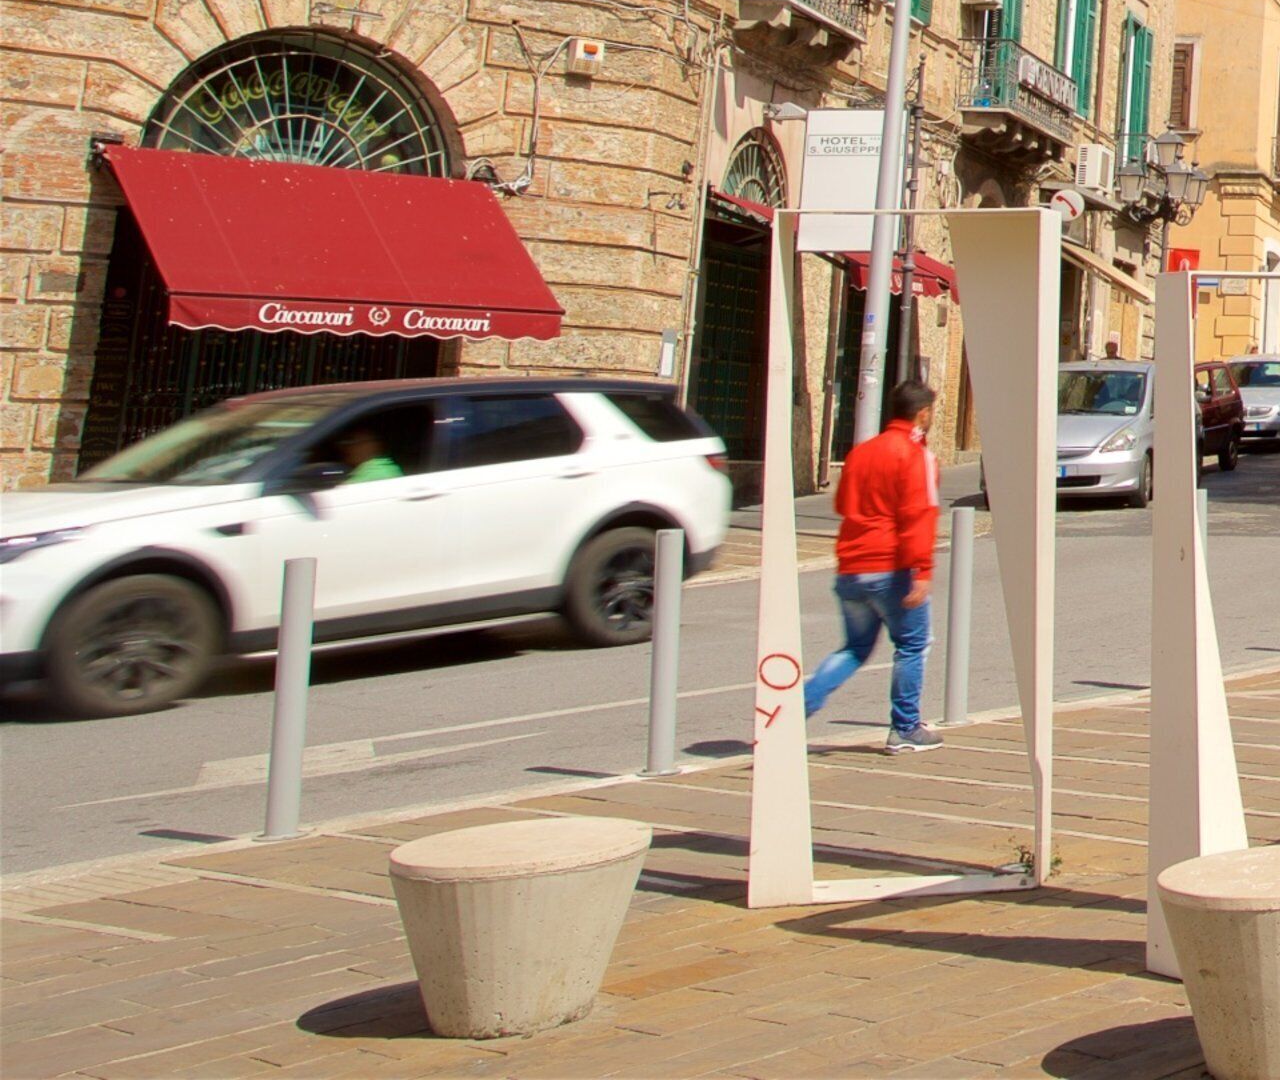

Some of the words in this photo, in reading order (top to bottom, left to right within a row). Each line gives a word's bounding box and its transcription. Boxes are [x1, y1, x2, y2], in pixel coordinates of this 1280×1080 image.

[820, 136, 867, 145] HOTEL
[258, 302, 355, 326] Caccavari
[403, 308, 491, 332] Caccavari
